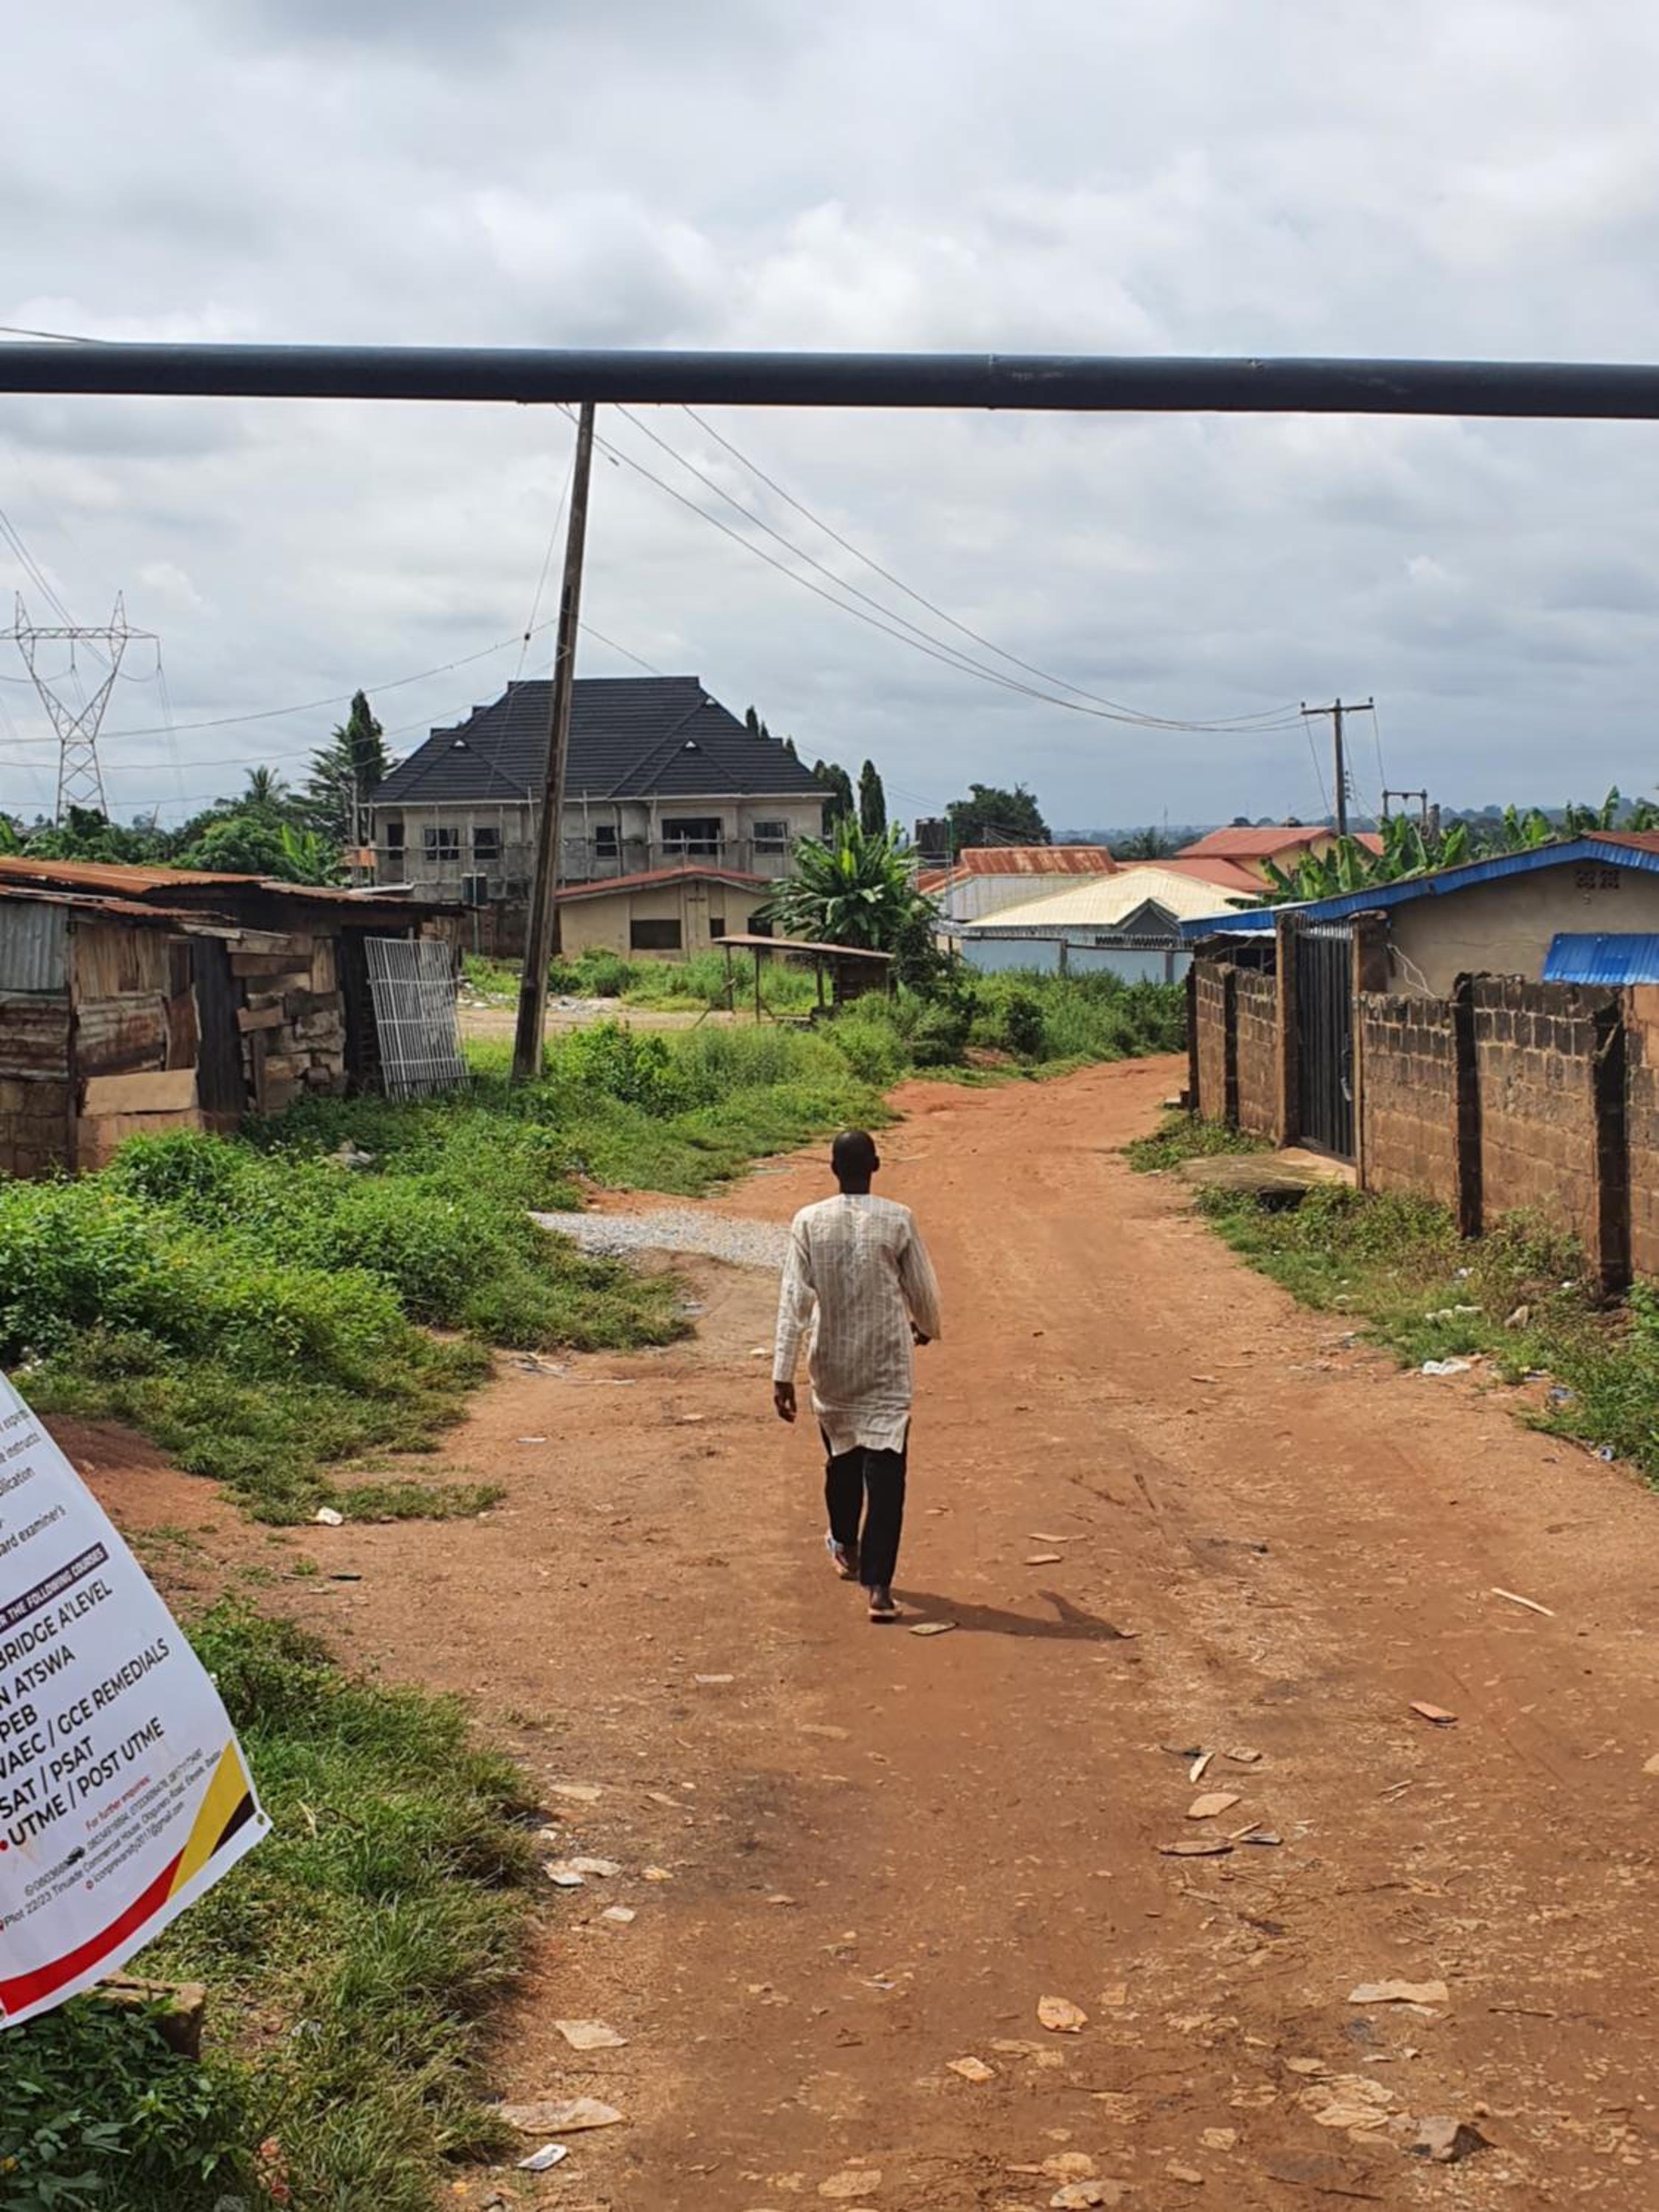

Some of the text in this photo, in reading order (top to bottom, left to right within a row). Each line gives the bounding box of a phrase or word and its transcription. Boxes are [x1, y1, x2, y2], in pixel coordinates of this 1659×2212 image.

[0, 1534, 18, 1558] ard
[7, 1601, 28, 1621] THE
[26, 1569, 73, 1608] FOLLOWING
[70, 1548, 104, 1577] COURSES
[58, 1579, 112, 1628] A'LEVEL
[15, 1645, 76, 1699] ATSWA
[47, 1719, 55, 1747] /
[58, 1698, 93, 1734] GCE
[92, 1638, 170, 1710] REMEDIALS
[0, 1704, 38, 1743] PEB
[0, 1736, 94, 1819] SAT / PSAT
[8, 1794, 67, 1846] UTME
[68, 1780, 76, 1809] /
[77, 1750, 120, 1798] POST
[120, 1717, 164, 1761] UTME
